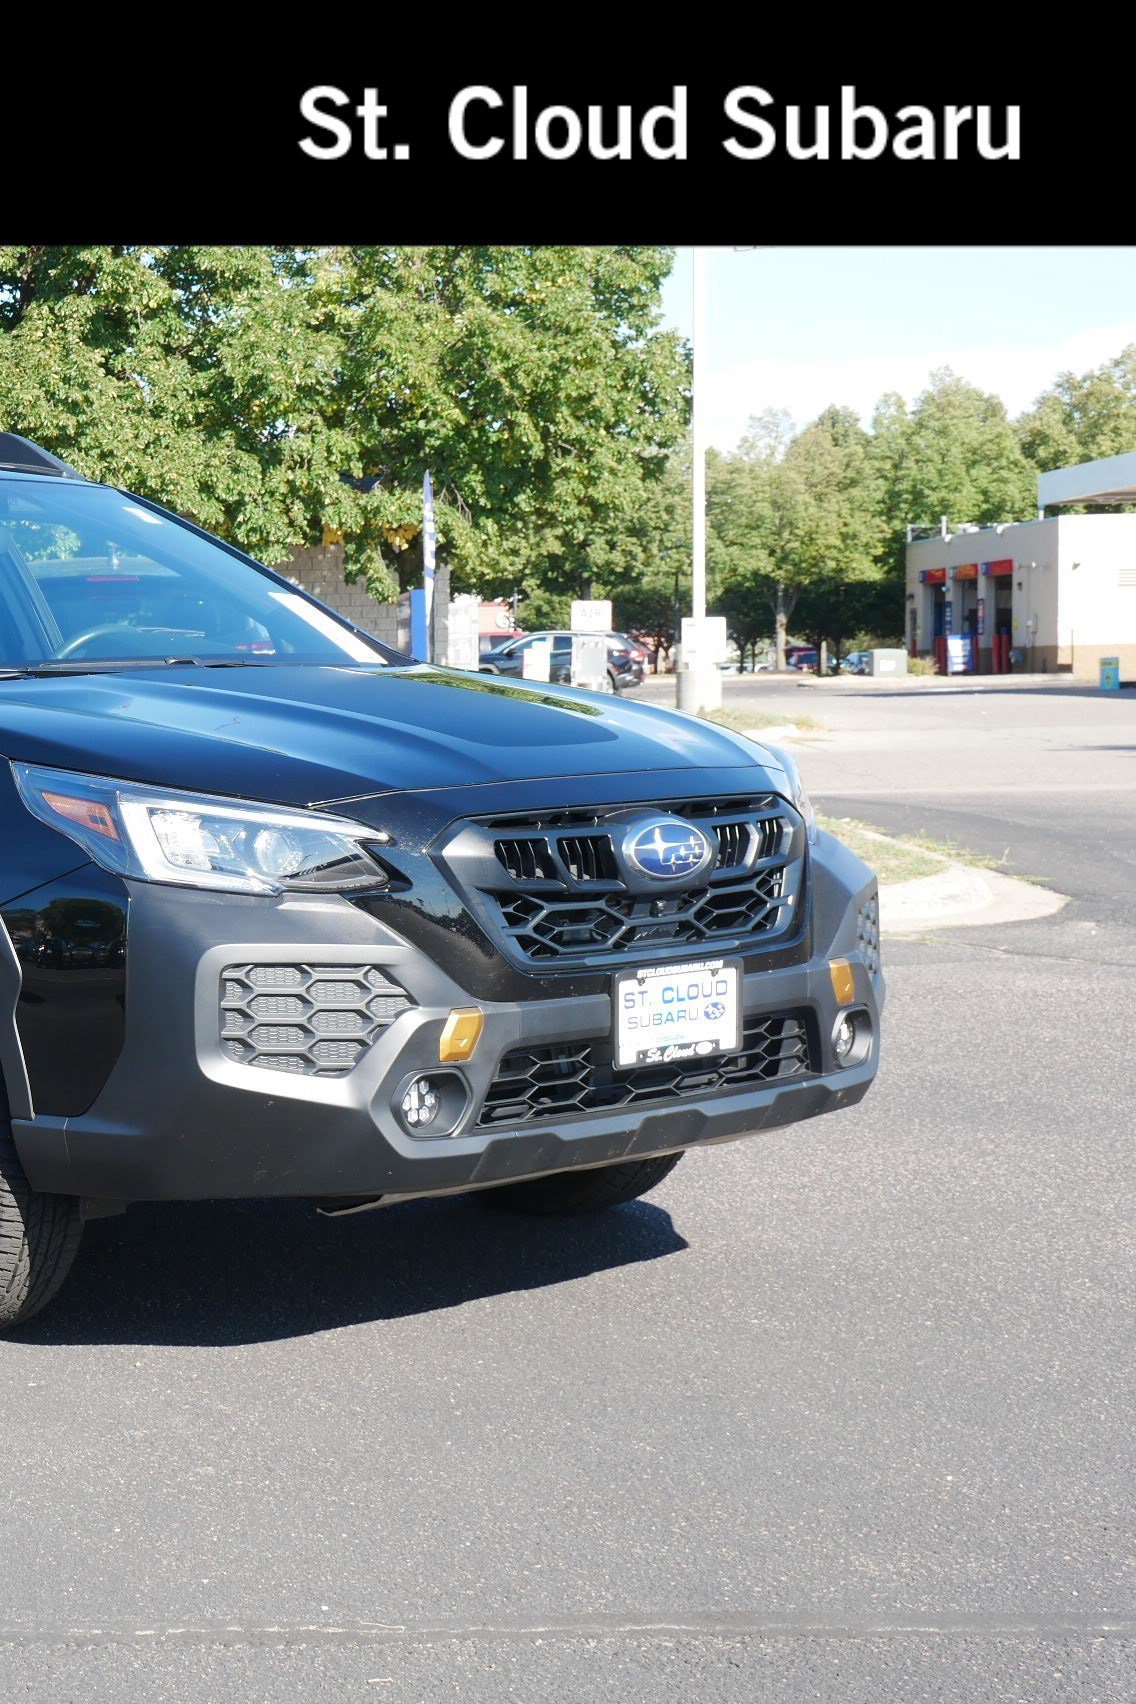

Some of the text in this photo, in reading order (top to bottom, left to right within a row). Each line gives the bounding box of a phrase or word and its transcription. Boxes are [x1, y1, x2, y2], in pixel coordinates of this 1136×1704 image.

[580, 607, 602, 618] AIR
[624, 979, 728, 1009] ST. CLOUD
[627, 1007, 699, 1030] SUBARU
[646, 1042, 696, 1063] St. Cloud
